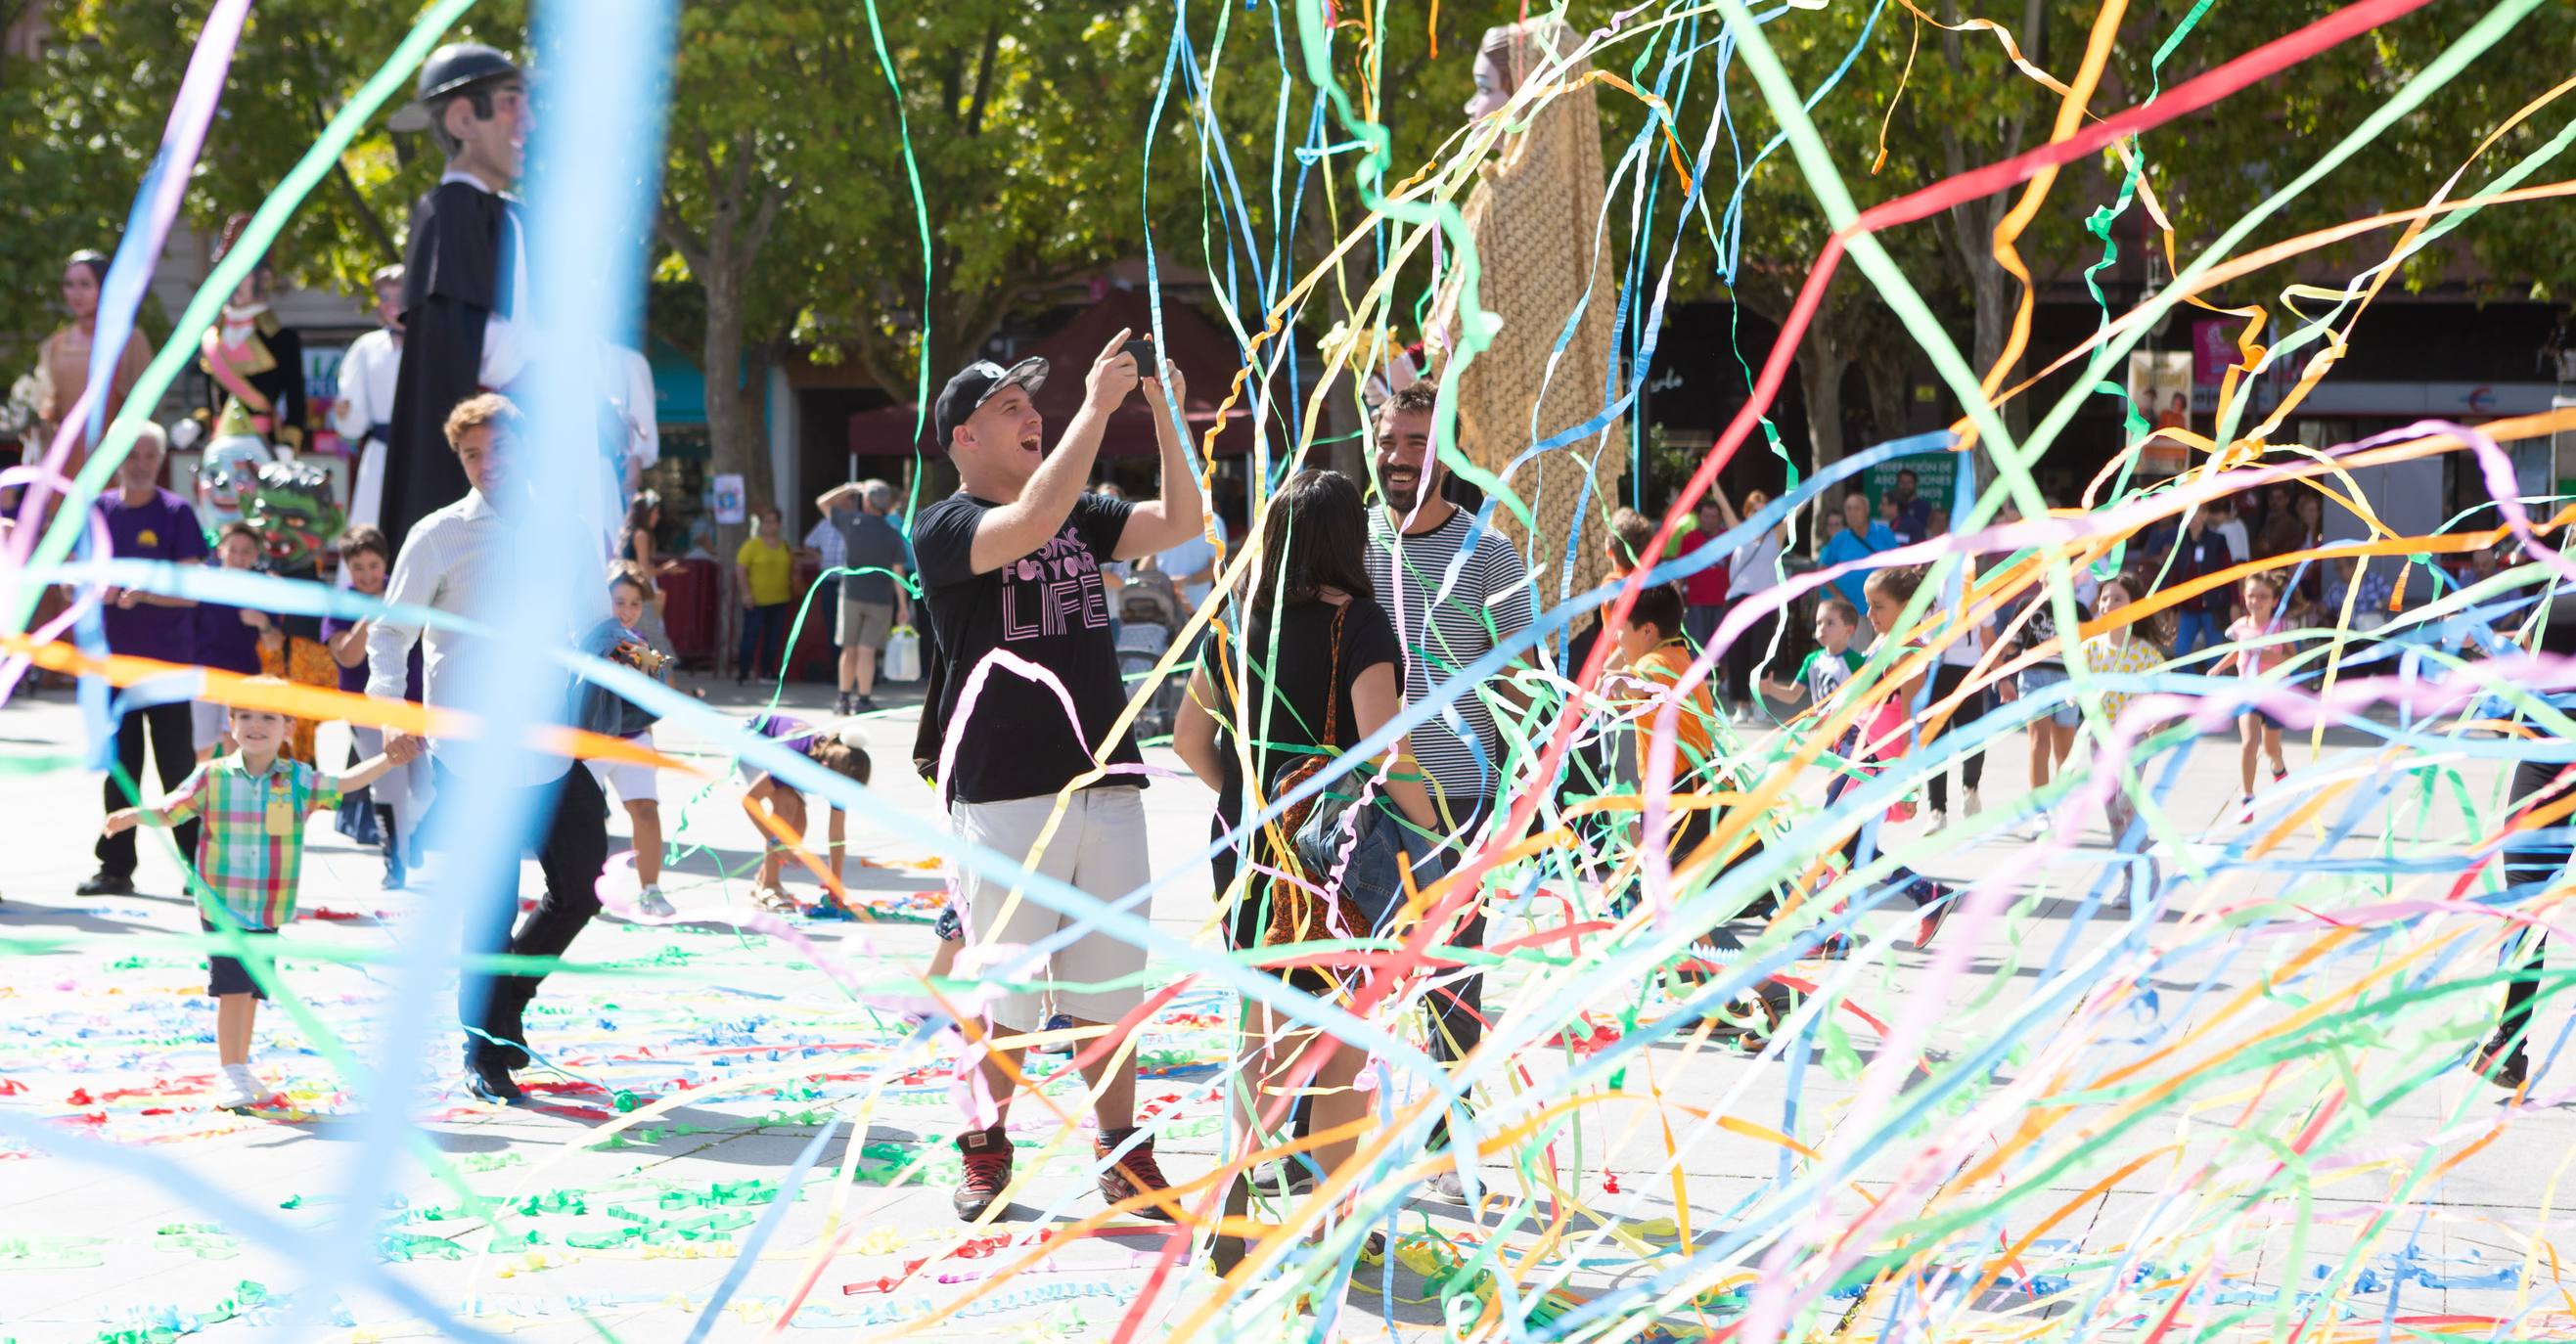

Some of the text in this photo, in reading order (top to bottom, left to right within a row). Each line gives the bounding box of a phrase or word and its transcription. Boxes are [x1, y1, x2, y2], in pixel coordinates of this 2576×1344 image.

[1002, 552, 1098, 584] FOR YOUR
[1003, 573, 1108, 641] LIFE
